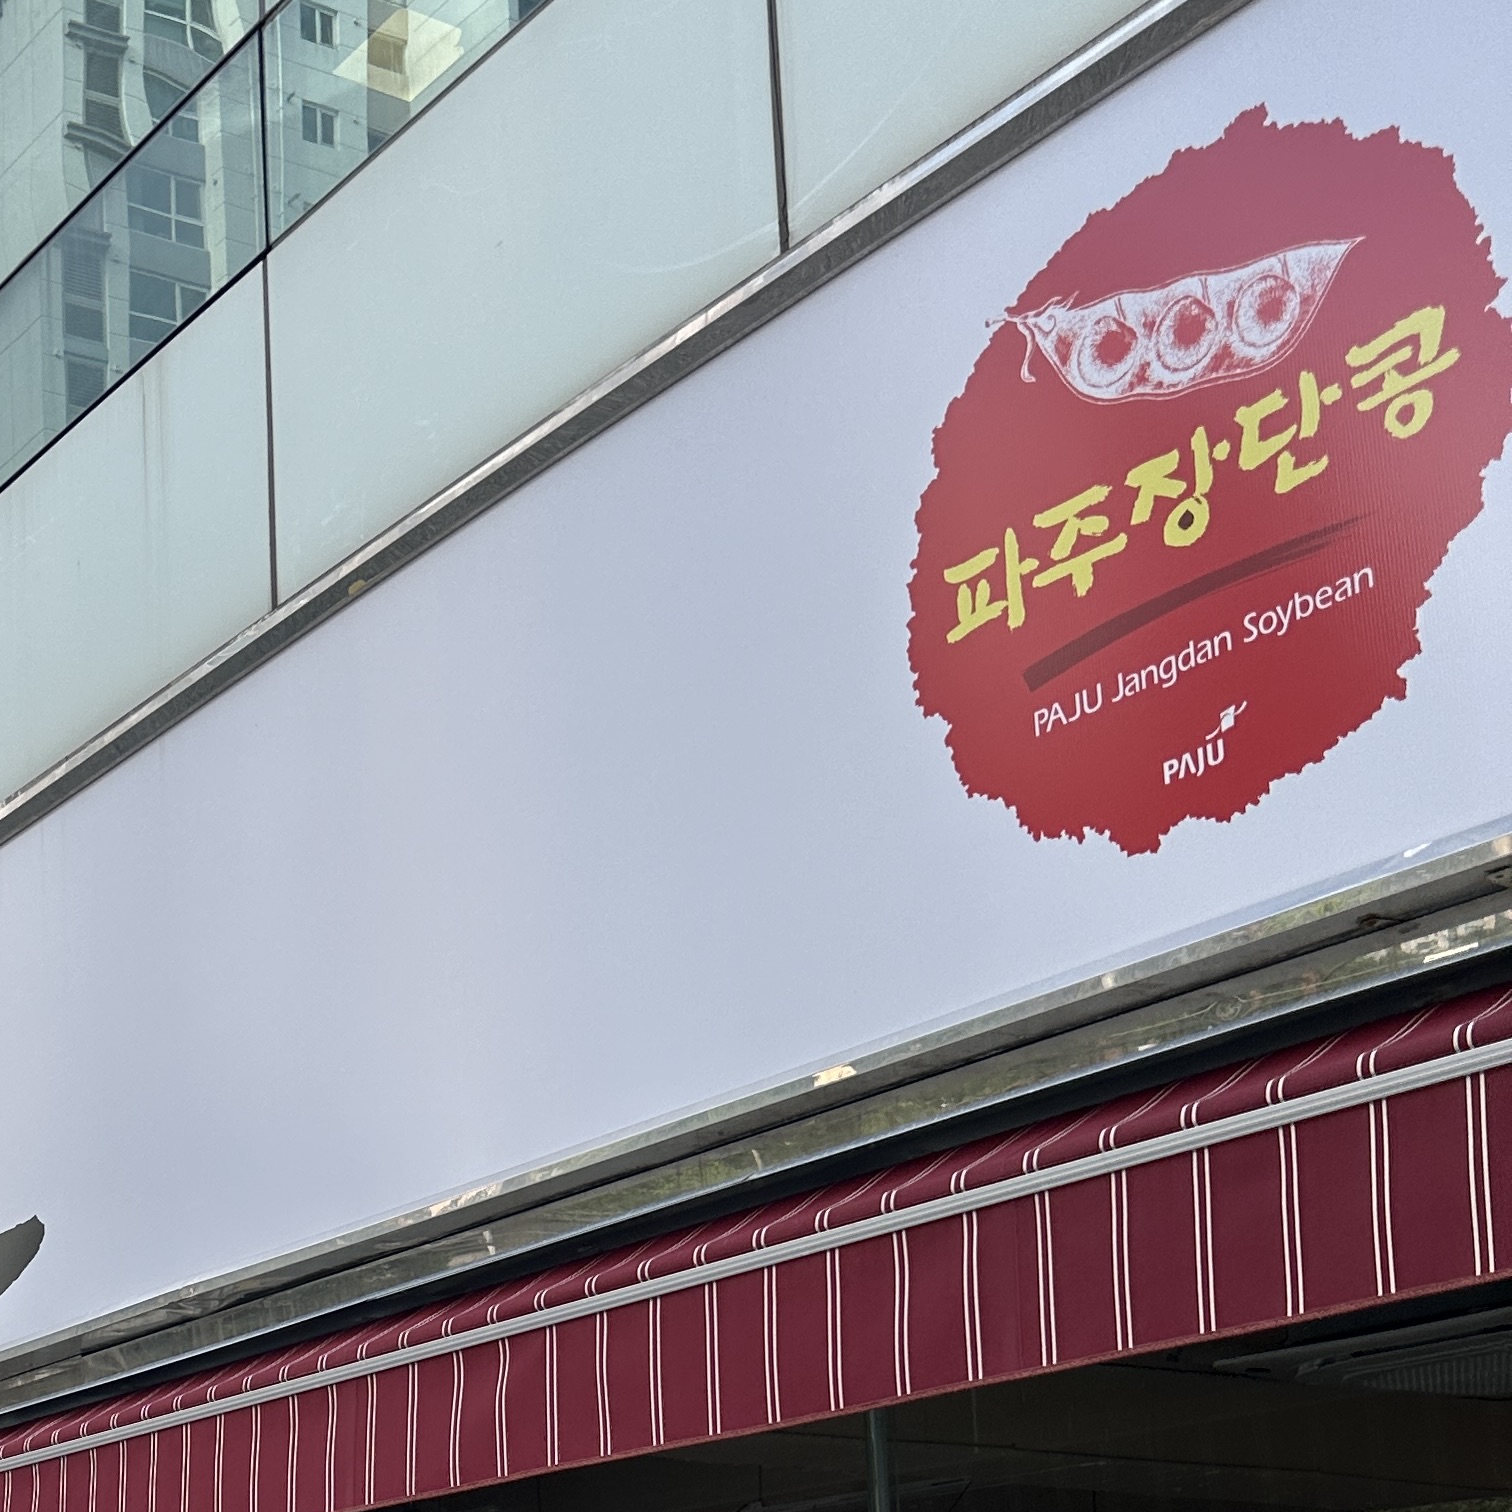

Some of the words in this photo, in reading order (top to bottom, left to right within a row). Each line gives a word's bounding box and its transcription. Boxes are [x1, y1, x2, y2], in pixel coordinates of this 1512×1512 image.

[1033, 683, 1103, 737] PAJU
[1112, 629, 1233, 703] Jangdan
[1243, 566, 1374, 643] Soybean
[1163, 737, 1225, 785] PAJU
